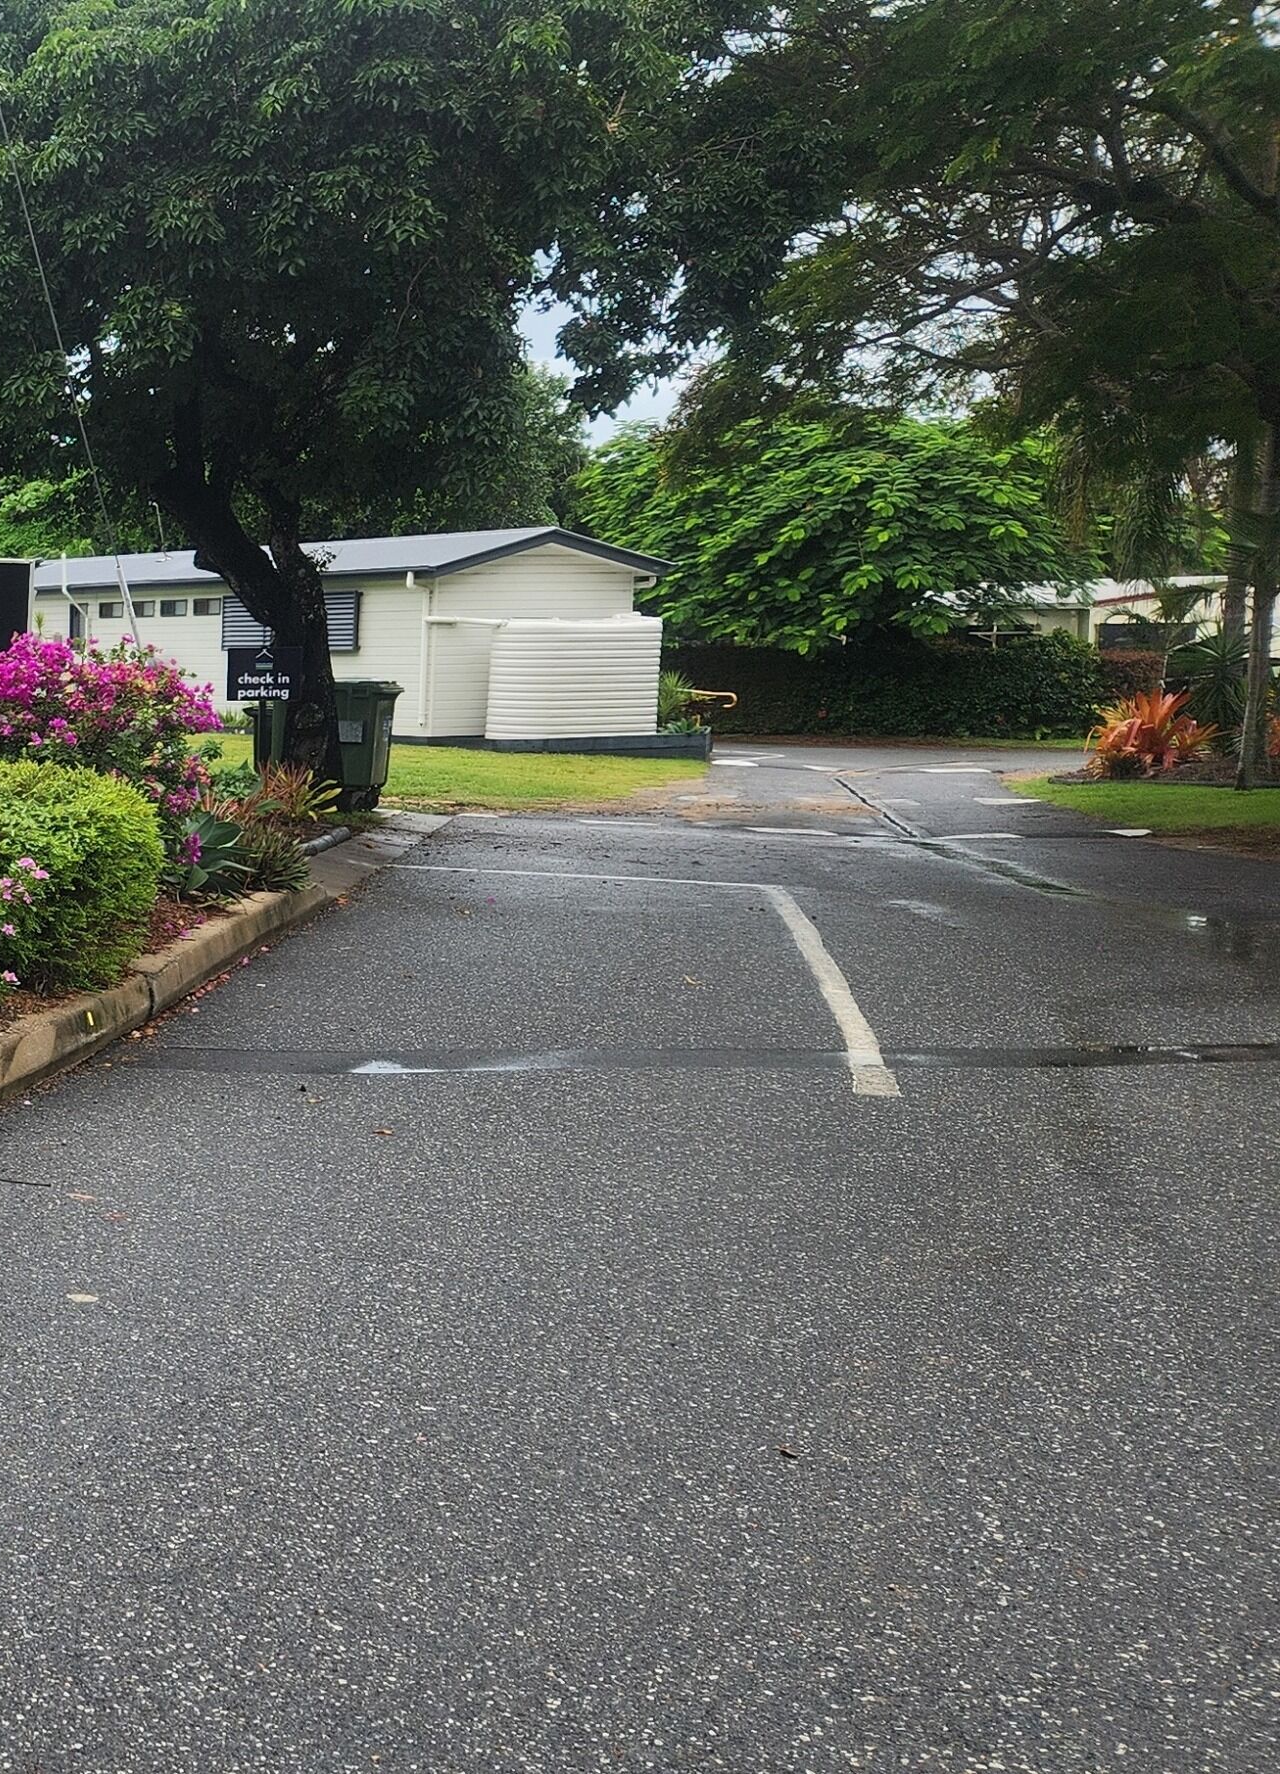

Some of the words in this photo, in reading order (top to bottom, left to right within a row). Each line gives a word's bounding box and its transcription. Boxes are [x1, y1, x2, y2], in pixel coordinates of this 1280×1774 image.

[237, 672, 275, 685] check
[278, 672, 290, 685] in
[237, 686, 290, 701] parking
